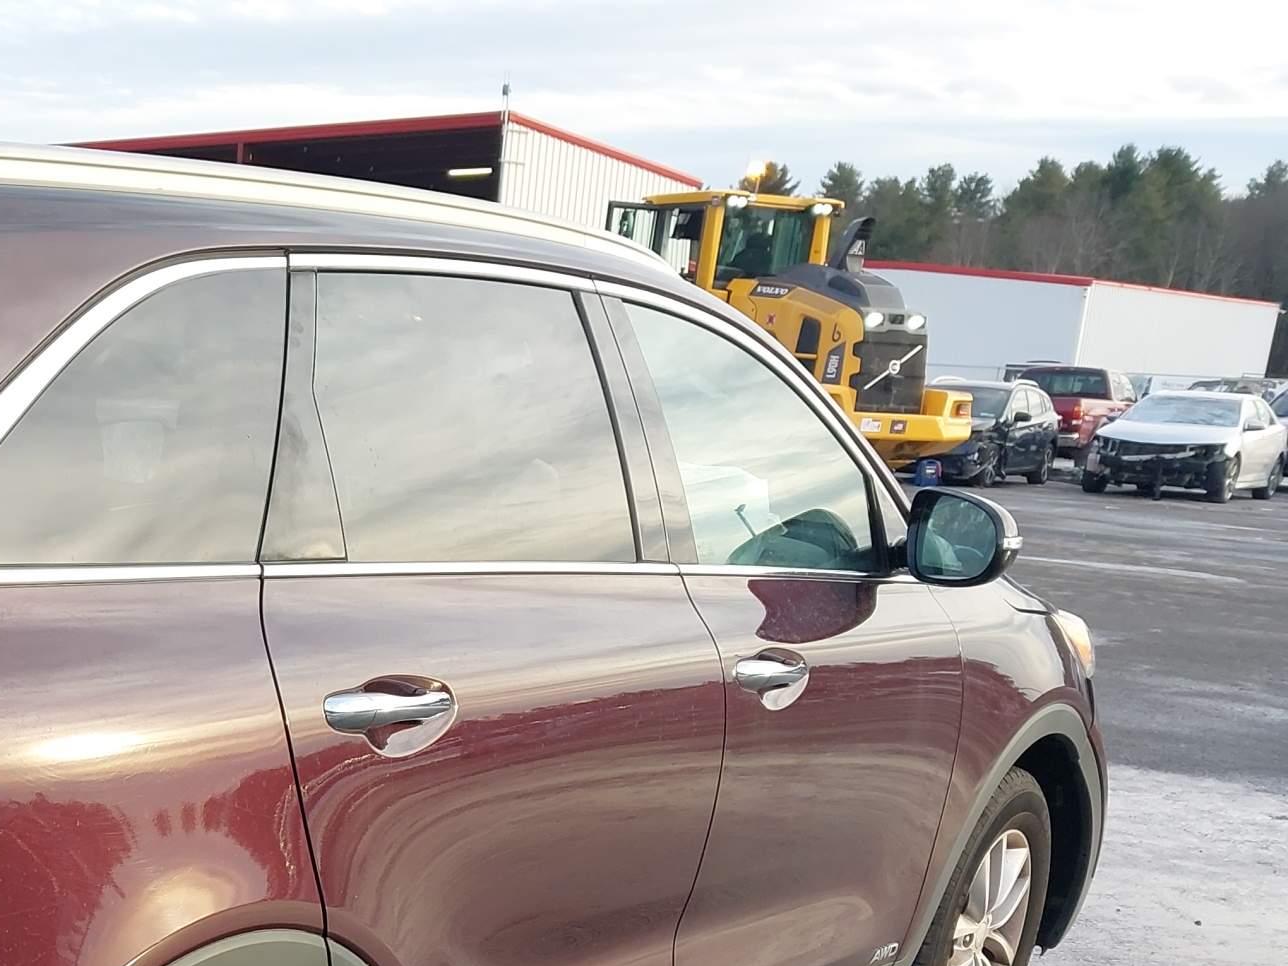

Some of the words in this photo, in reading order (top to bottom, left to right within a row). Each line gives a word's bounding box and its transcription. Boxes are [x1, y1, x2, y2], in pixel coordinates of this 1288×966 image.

[756, 285, 789, 296] VOLVO
[825, 354, 840, 379] L90H
[868, 941, 900, 965] AWD
